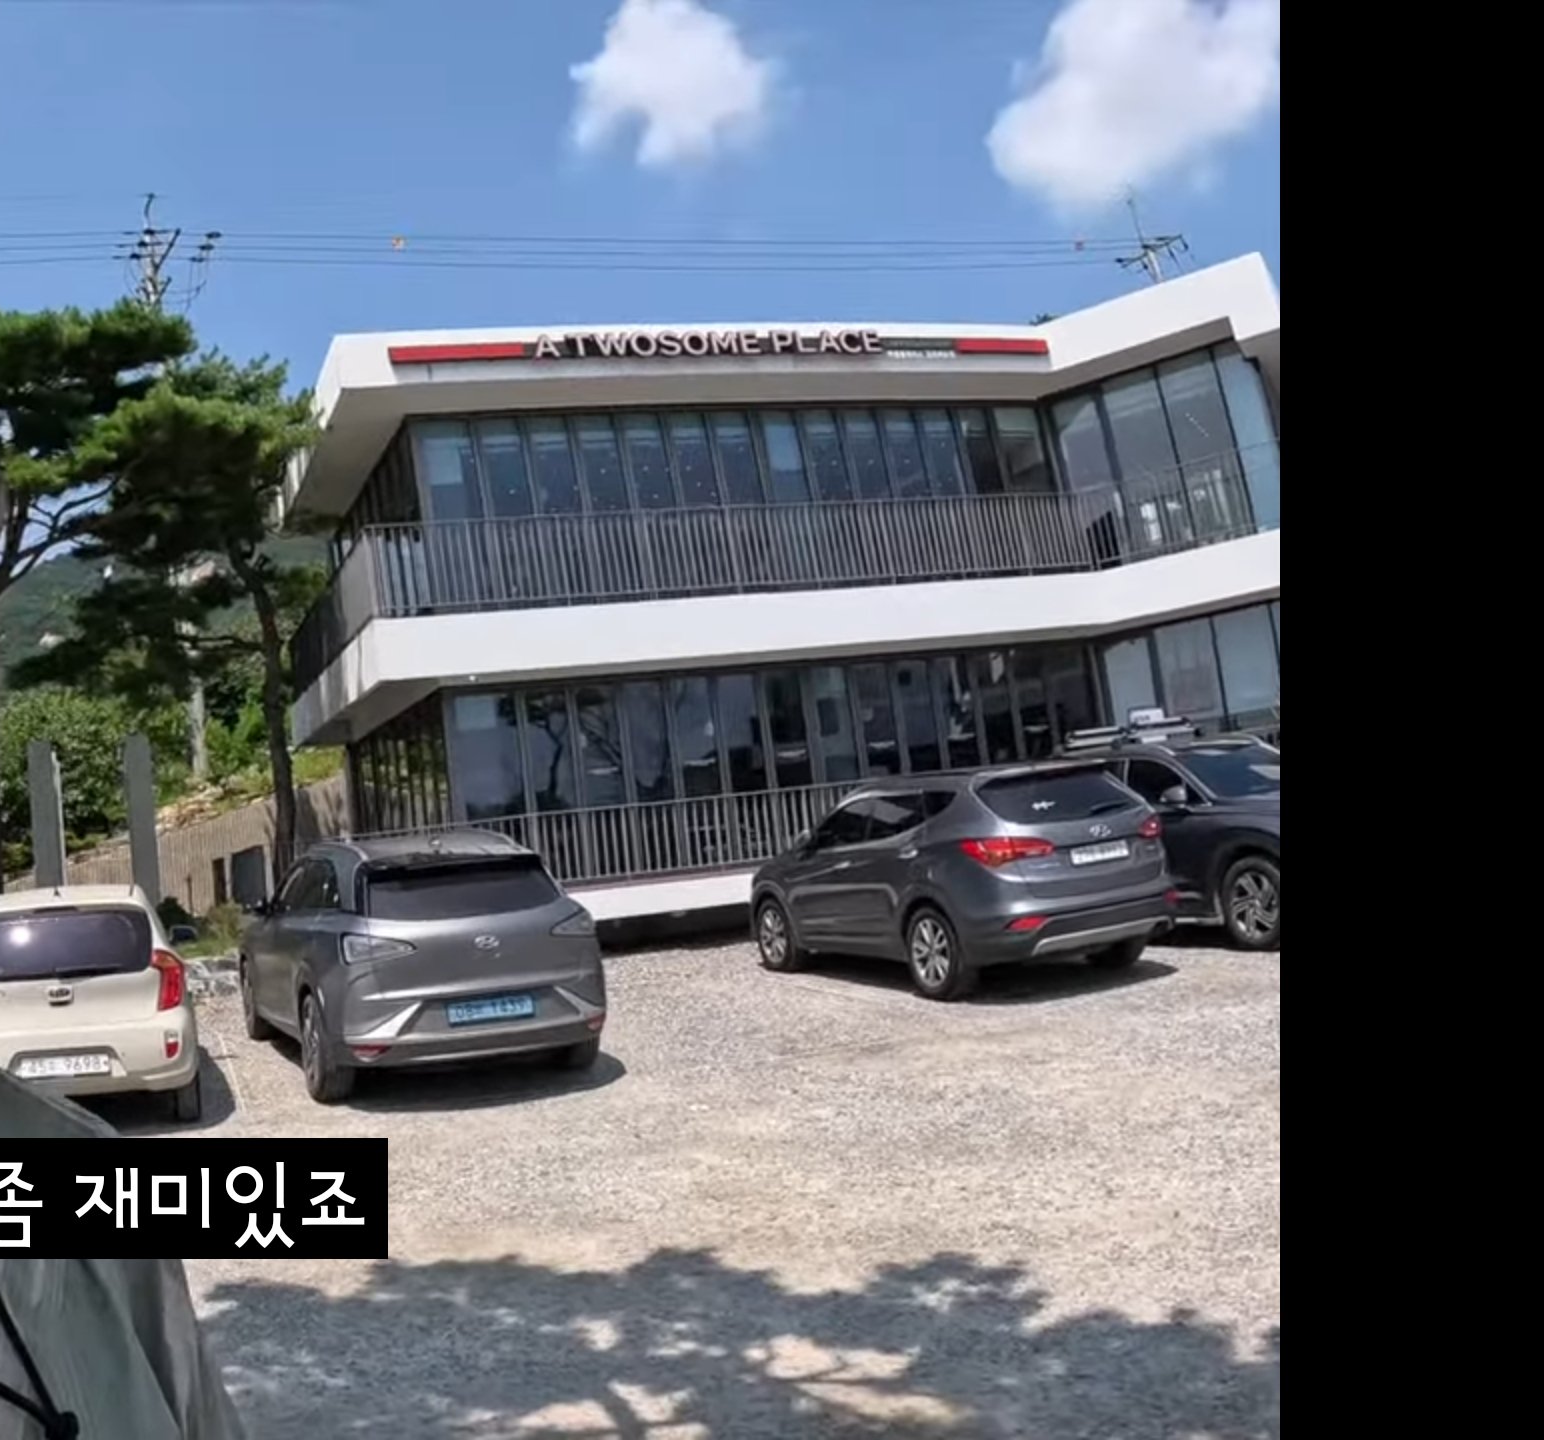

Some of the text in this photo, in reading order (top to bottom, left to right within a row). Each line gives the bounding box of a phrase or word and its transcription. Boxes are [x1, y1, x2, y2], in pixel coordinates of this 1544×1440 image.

[535, 334, 561, 358] A
[565, 330, 761, 357] TWOSOME
[769, 329, 883, 354] PLACE
